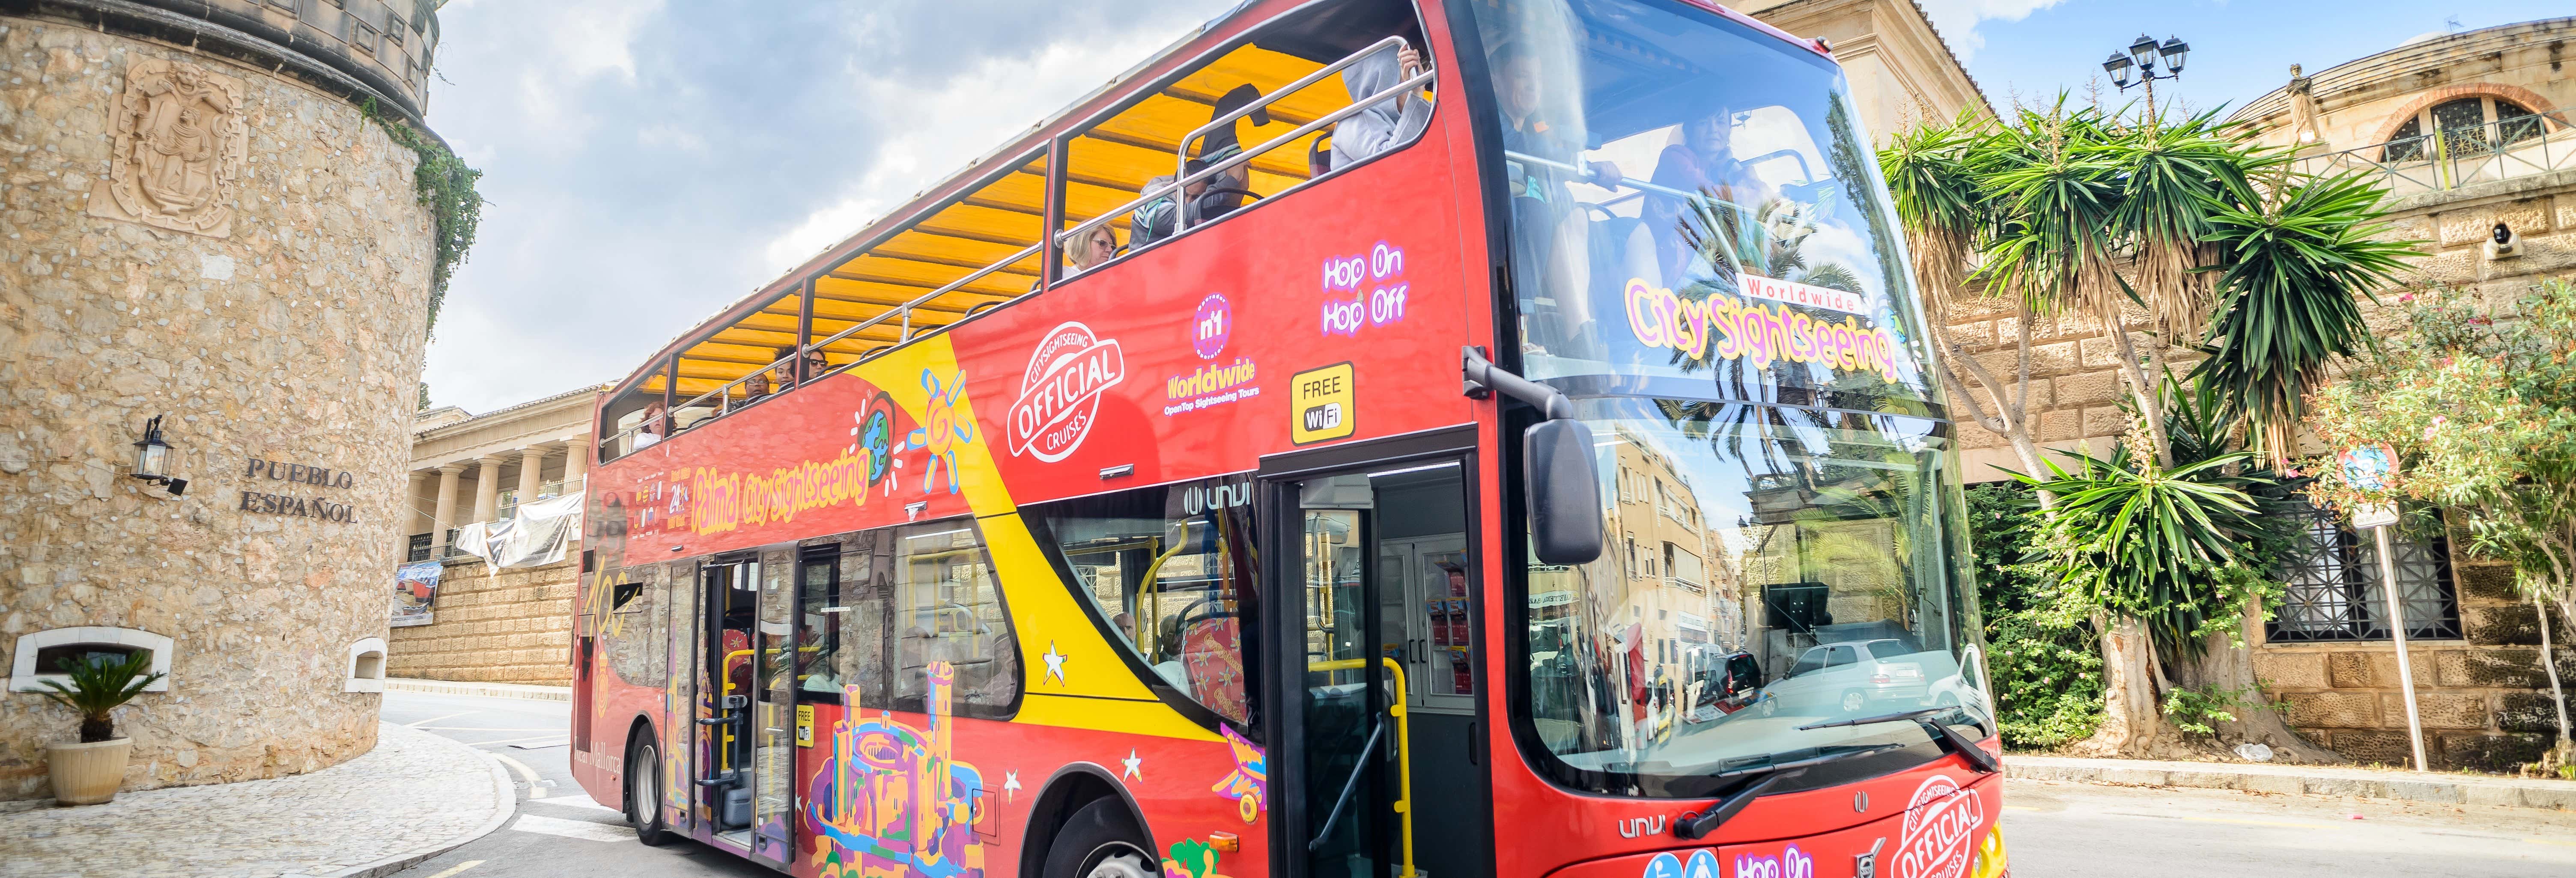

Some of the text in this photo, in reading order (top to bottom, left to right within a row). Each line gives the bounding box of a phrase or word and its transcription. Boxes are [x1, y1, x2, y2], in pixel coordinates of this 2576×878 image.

[1324, 244, 1402, 289] Hop On
[1323, 285, 1407, 333] Hop Off
[1747, 277, 1855, 312] Worldwide
[1031, 332, 1088, 384] CITYSIGHTSEEING
[1167, 358, 1255, 399] Worldwide
[1018, 349, 1115, 439] OFFICIAL
[1164, 387, 1260, 416] OpenTop Sightseeing Tours
[1303, 376, 1341, 400] FREE
[1046, 410, 1087, 451] CRUISES
[247, 458, 353, 489] PUEBLO
[241, 491, 358, 524] ESPAÑOL
[691, 466, 740, 536] Palma
[798, 711, 811, 721] FREE
[590, 740, 621, 774] Mallorca
[1902, 798, 1978, 878] OFFICIAL
